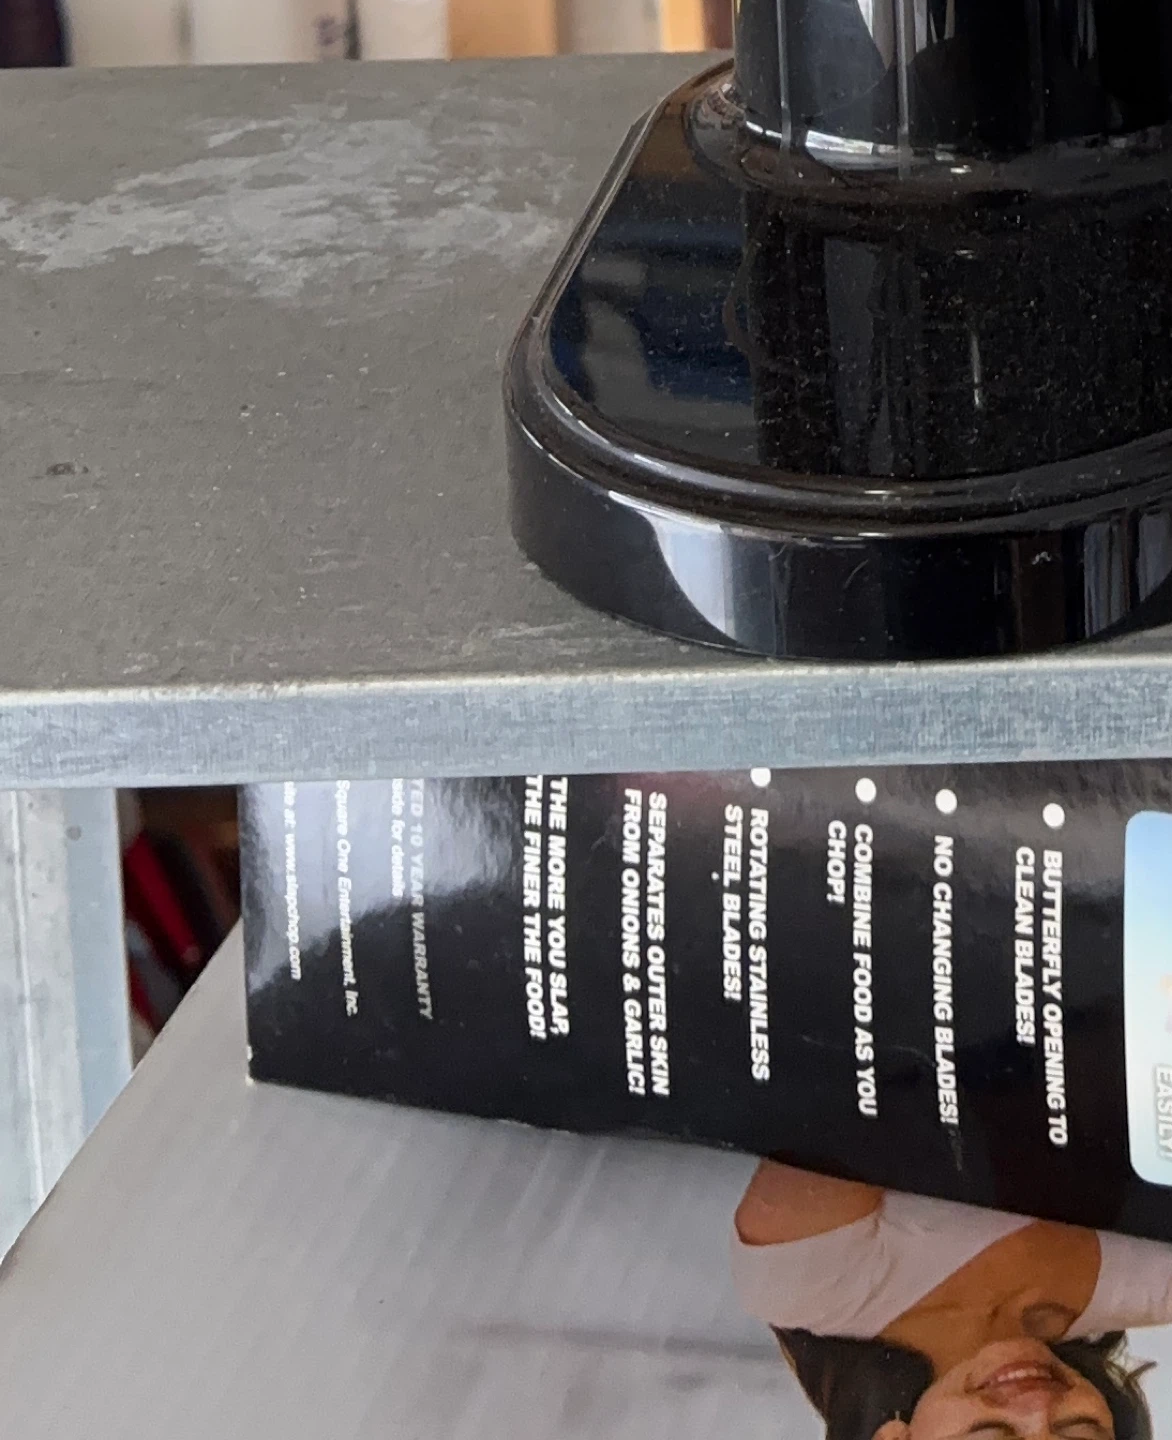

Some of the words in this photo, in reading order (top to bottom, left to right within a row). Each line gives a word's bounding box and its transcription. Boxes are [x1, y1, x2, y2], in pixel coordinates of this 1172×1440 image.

[335, 780, 350, 836] Square
[391, 778, 405, 815] side
[391, 819, 405, 841] for
[410, 822, 423, 847] 10
[524, 775, 543, 826] THE
[549, 777, 568, 831] THE
[622, 788, 642, 864] FROM
[337, 838, 351, 874] One
[391, 844, 405, 898] details
[410, 852, 424, 907] YEAR
[523, 830, 541, 908] FINER
[547, 835, 566, 911] MORE
[646, 790, 667, 942] SEPARATES
[723, 803, 743, 888] STEEL
[748, 807, 769, 941] ROTATING
[826, 820, 847, 905] CHOP!
[933, 835, 954, 877] NO
[284, 833, 301, 980] www.slapchop.com
[621, 868, 641, 969] ONIONS
[852, 823, 873, 949] COMBINE
[1015, 846, 1036, 935] CLEAN
[523, 912, 542, 963] THE
[547, 916, 566, 969] YOU
[722, 892, 742, 1001] BLADES!
[932, 881, 953, 1022] CHANGING
[1041, 848, 1063, 1001] BUTTERFLY
[411, 912, 433, 1020] WARRANTY
[524, 967, 546, 1040] FOOD!
[622, 973, 641, 993] &
[646, 945, 667, 1031] OUTER
[853, 952, 873, 1023] FOOD
[1014, 938, 1036, 1046] BLADES!
[550, 972, 570, 1037] SLAP,
[748, 944, 770, 1082] STAINLESS
[623, 998, 645, 1096] GARLIC!
[649, 1035, 670, 1095] SKIN
[854, 1026, 874, 1062] AS
[934, 1026, 959, 1125] BLADES!
[1042, 1002, 1066, 1111] OPENING
[856, 1065, 878, 1117] YOU
[1047, 1113, 1068, 1147] TO
